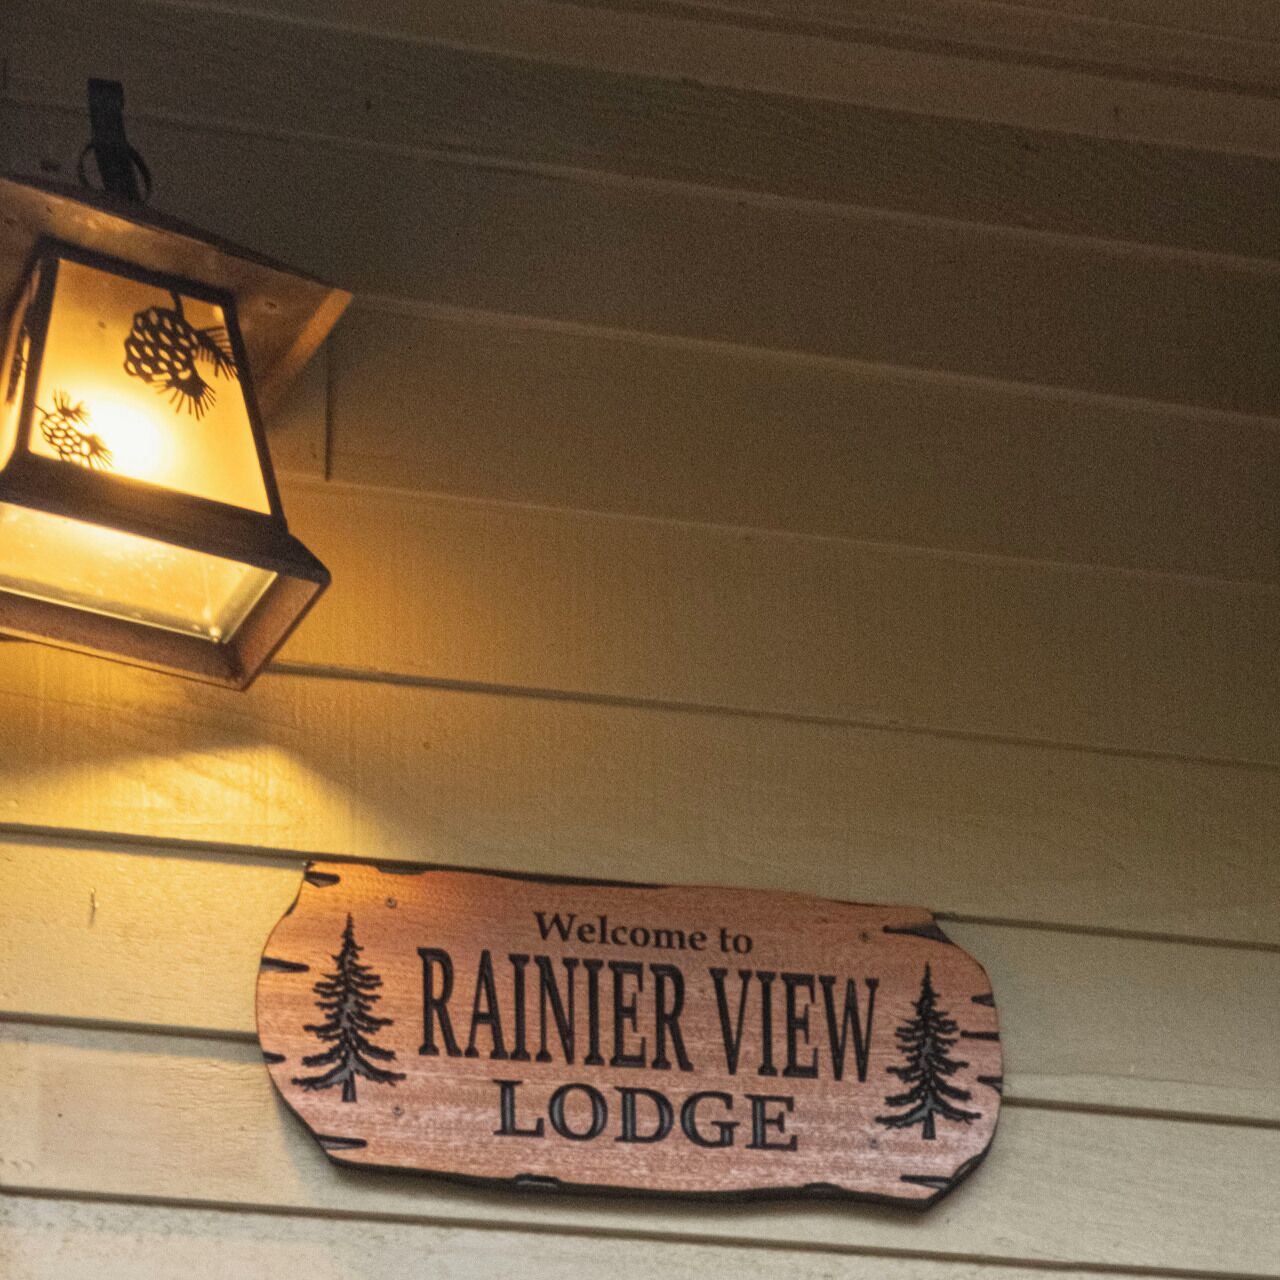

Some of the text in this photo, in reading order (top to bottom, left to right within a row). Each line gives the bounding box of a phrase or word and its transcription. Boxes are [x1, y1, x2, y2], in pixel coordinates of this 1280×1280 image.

[533, 911, 753, 955] Welcome to
[416, 947, 880, 1083] RAINIER VIEW
[493, 1079, 799, 1152] LODGE
